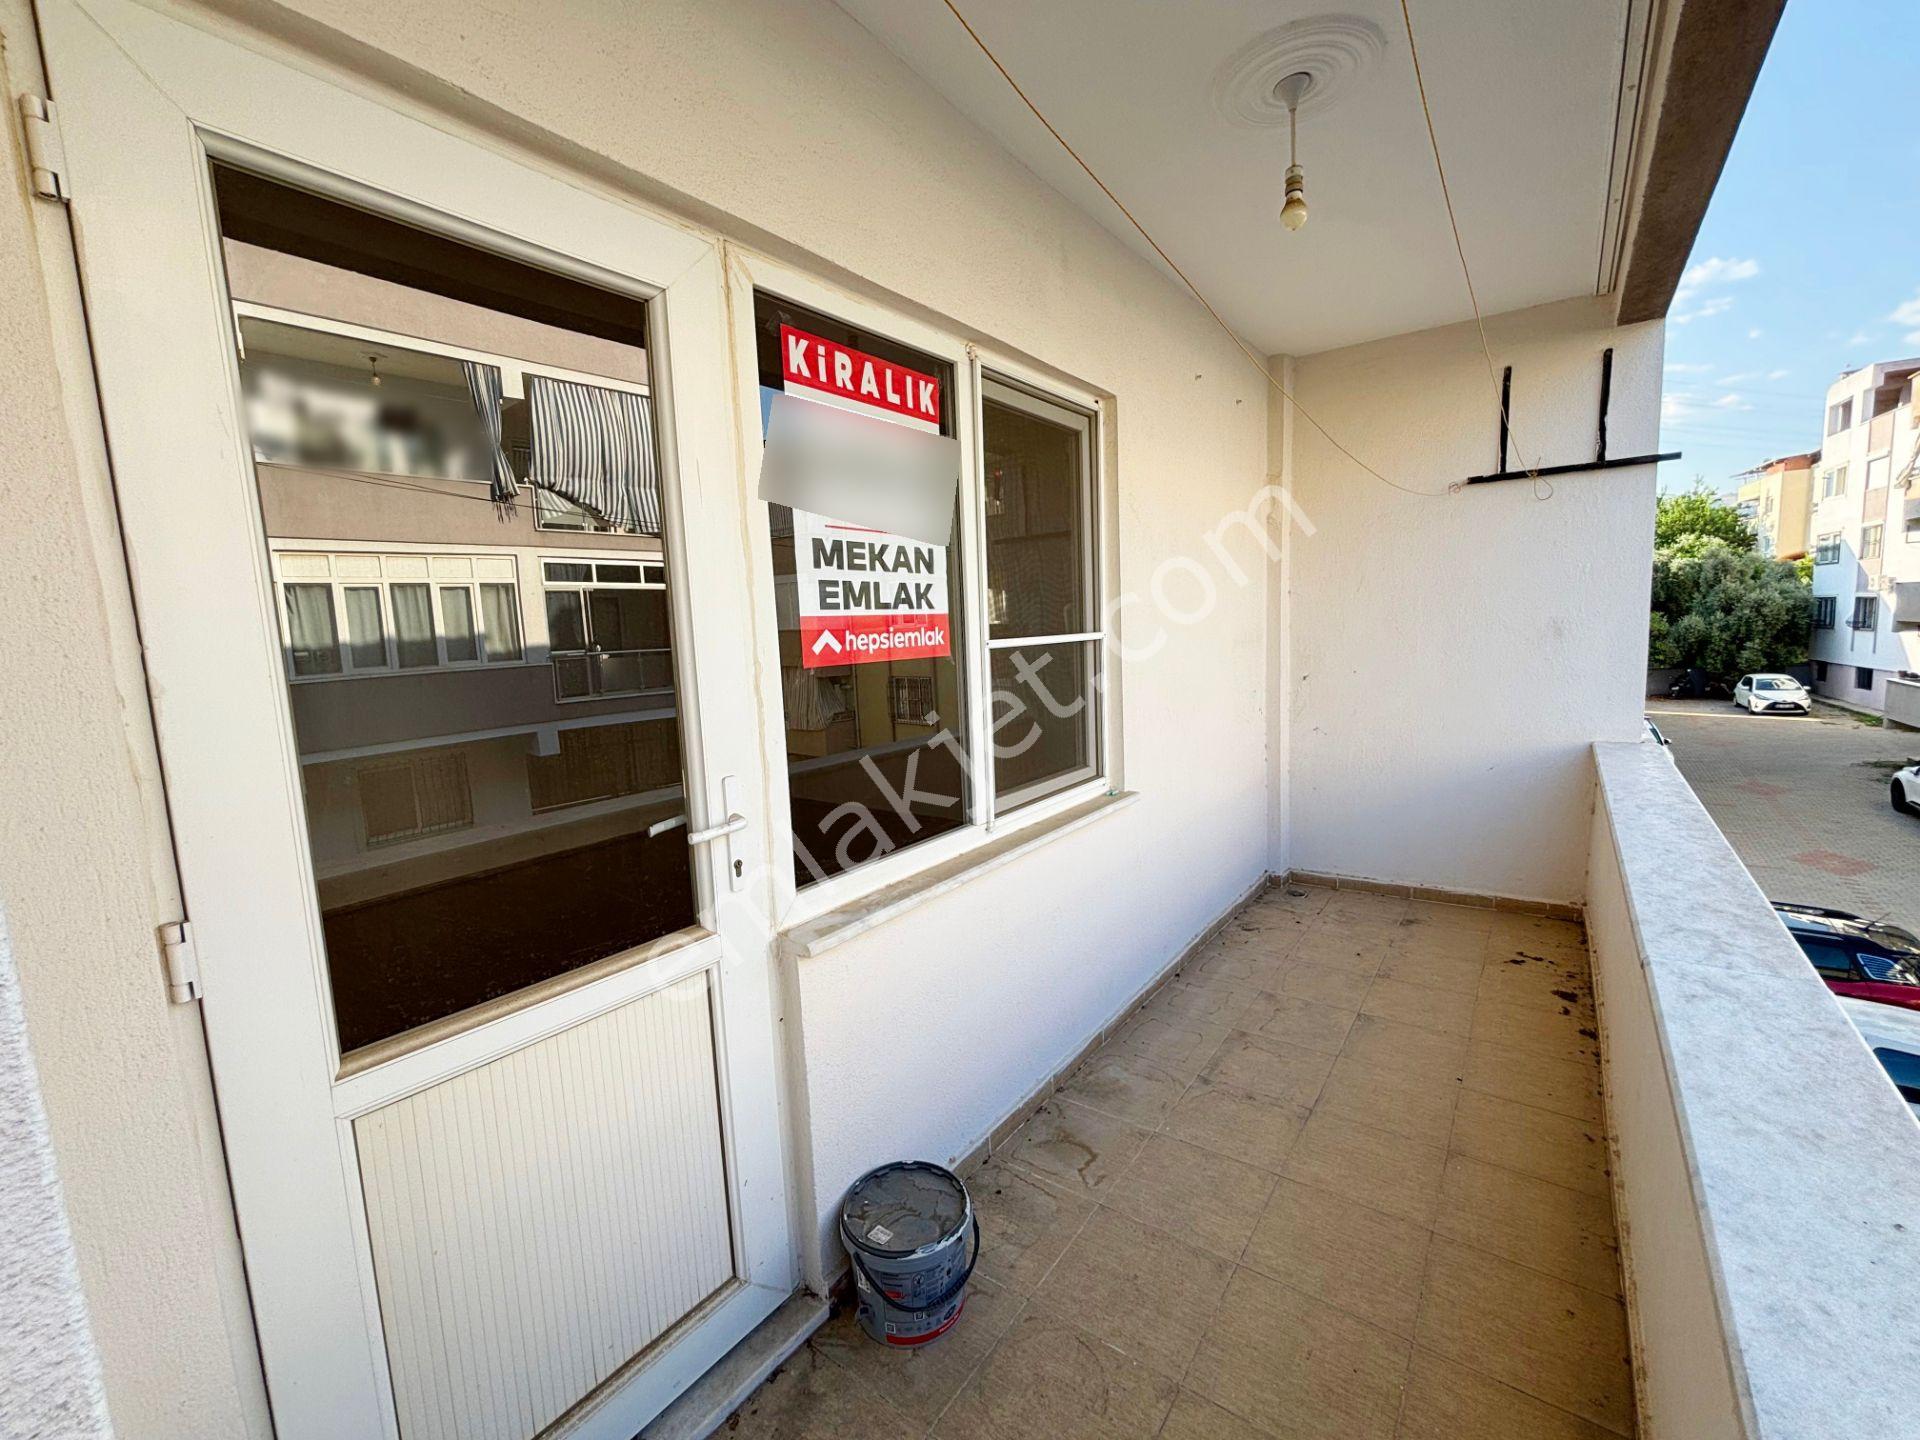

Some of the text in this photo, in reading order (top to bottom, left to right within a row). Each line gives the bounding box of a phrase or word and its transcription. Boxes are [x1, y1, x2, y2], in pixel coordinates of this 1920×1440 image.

[812, 537, 936, 575] MEKAN
[818, 579, 936, 611] EMLAK
[845, 627, 945, 654] hepsiemlak
